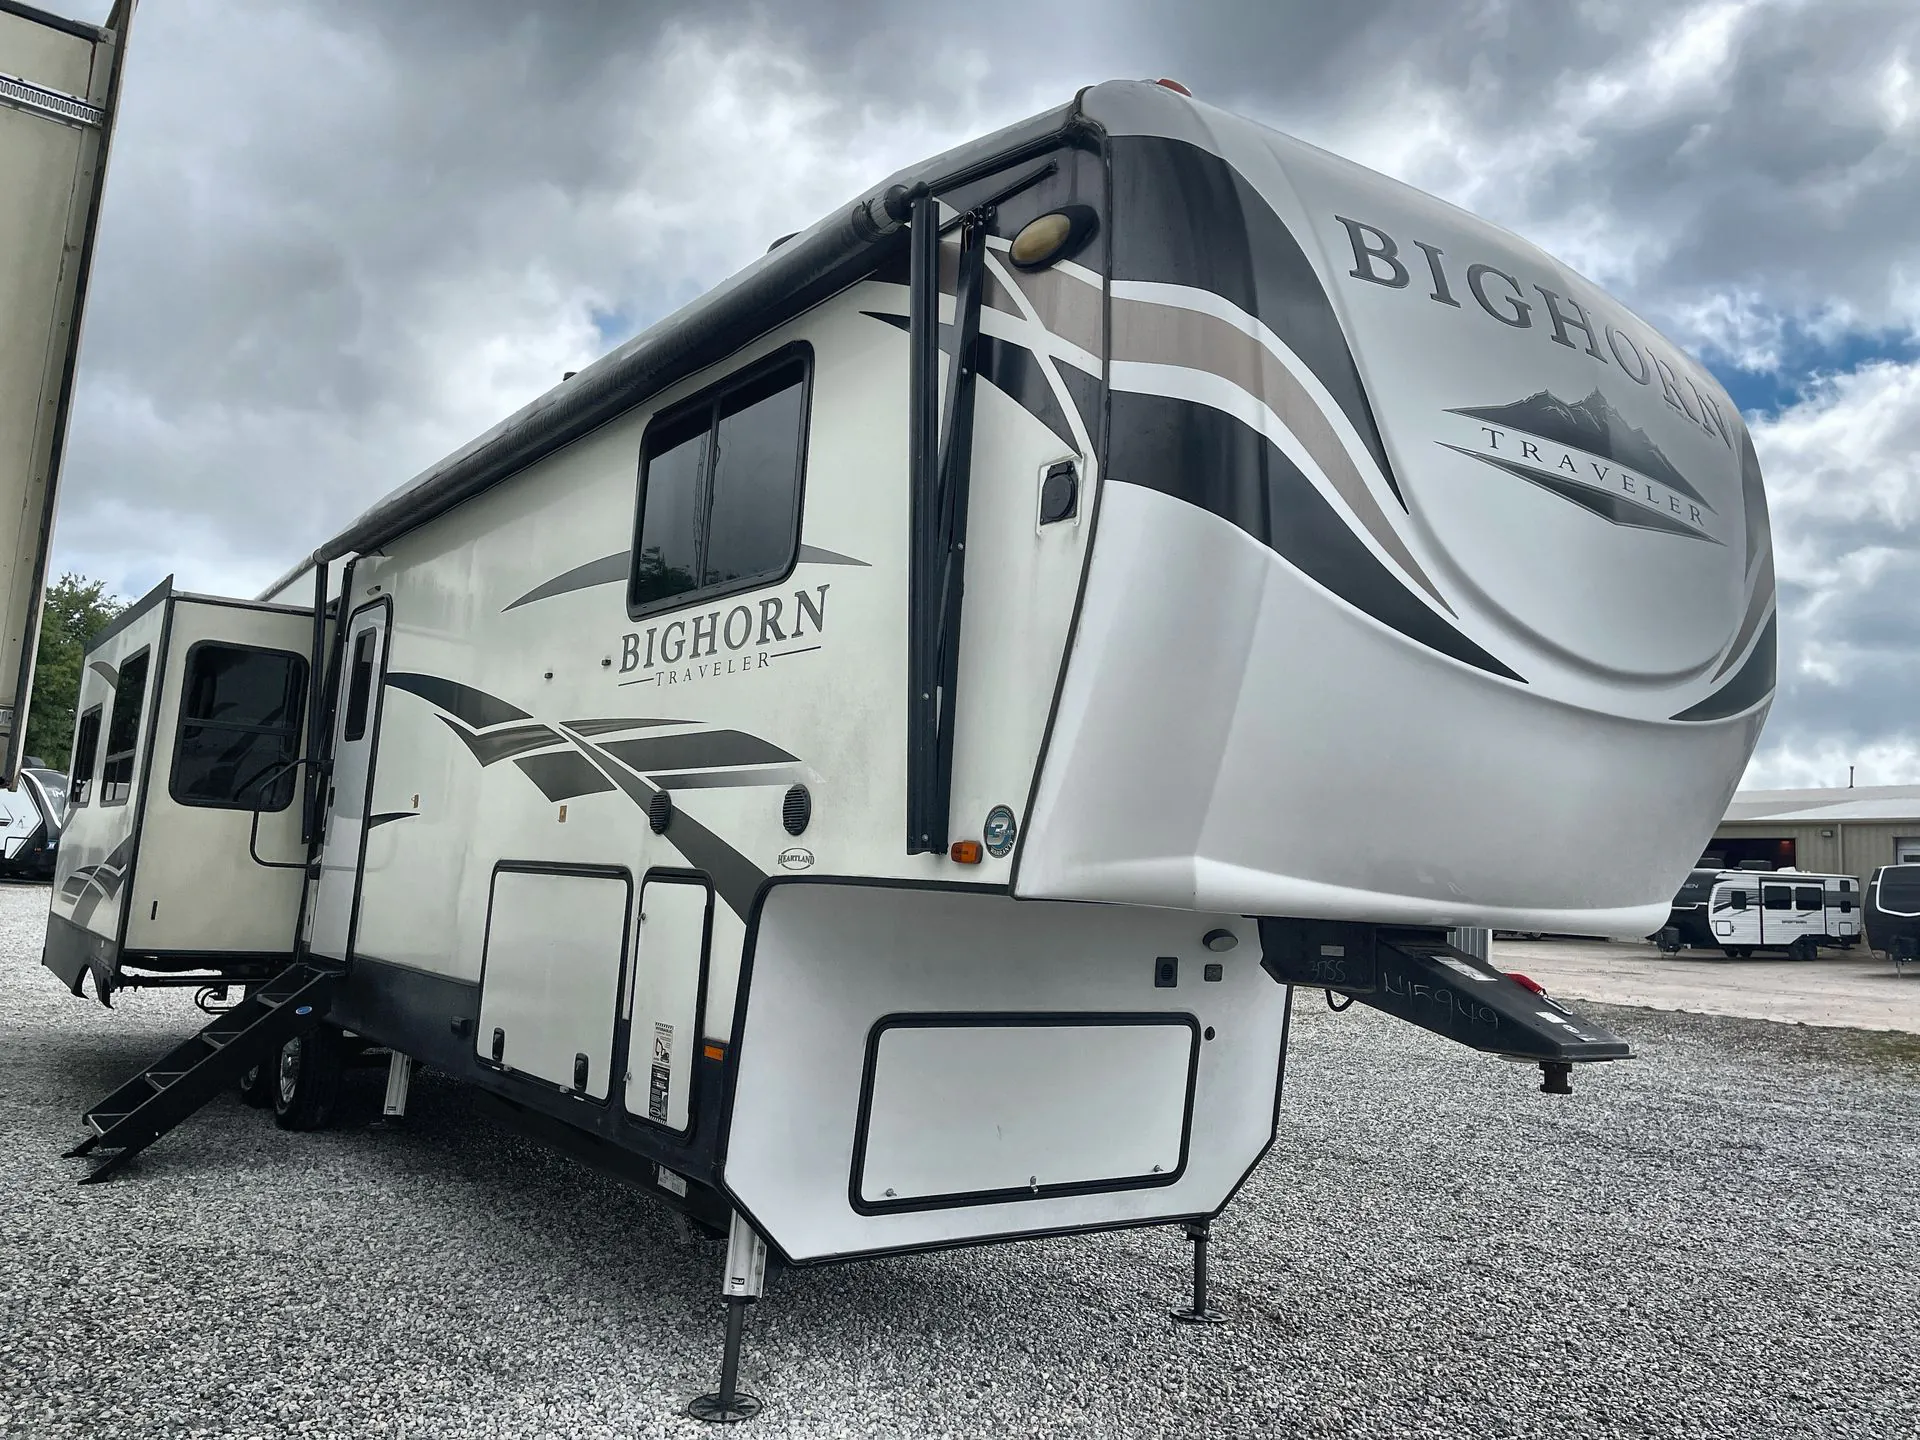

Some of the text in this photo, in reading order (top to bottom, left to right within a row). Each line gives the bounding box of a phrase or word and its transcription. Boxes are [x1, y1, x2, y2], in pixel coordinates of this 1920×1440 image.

[1334, 214, 1731, 450] BIGHORN
[1481, 427, 1704, 527] TRAVELER
[618, 584, 830, 674] BIGHORN
[656, 652, 770, 686] TRAVELER
[777, 854, 815, 865] HEARTLAND
